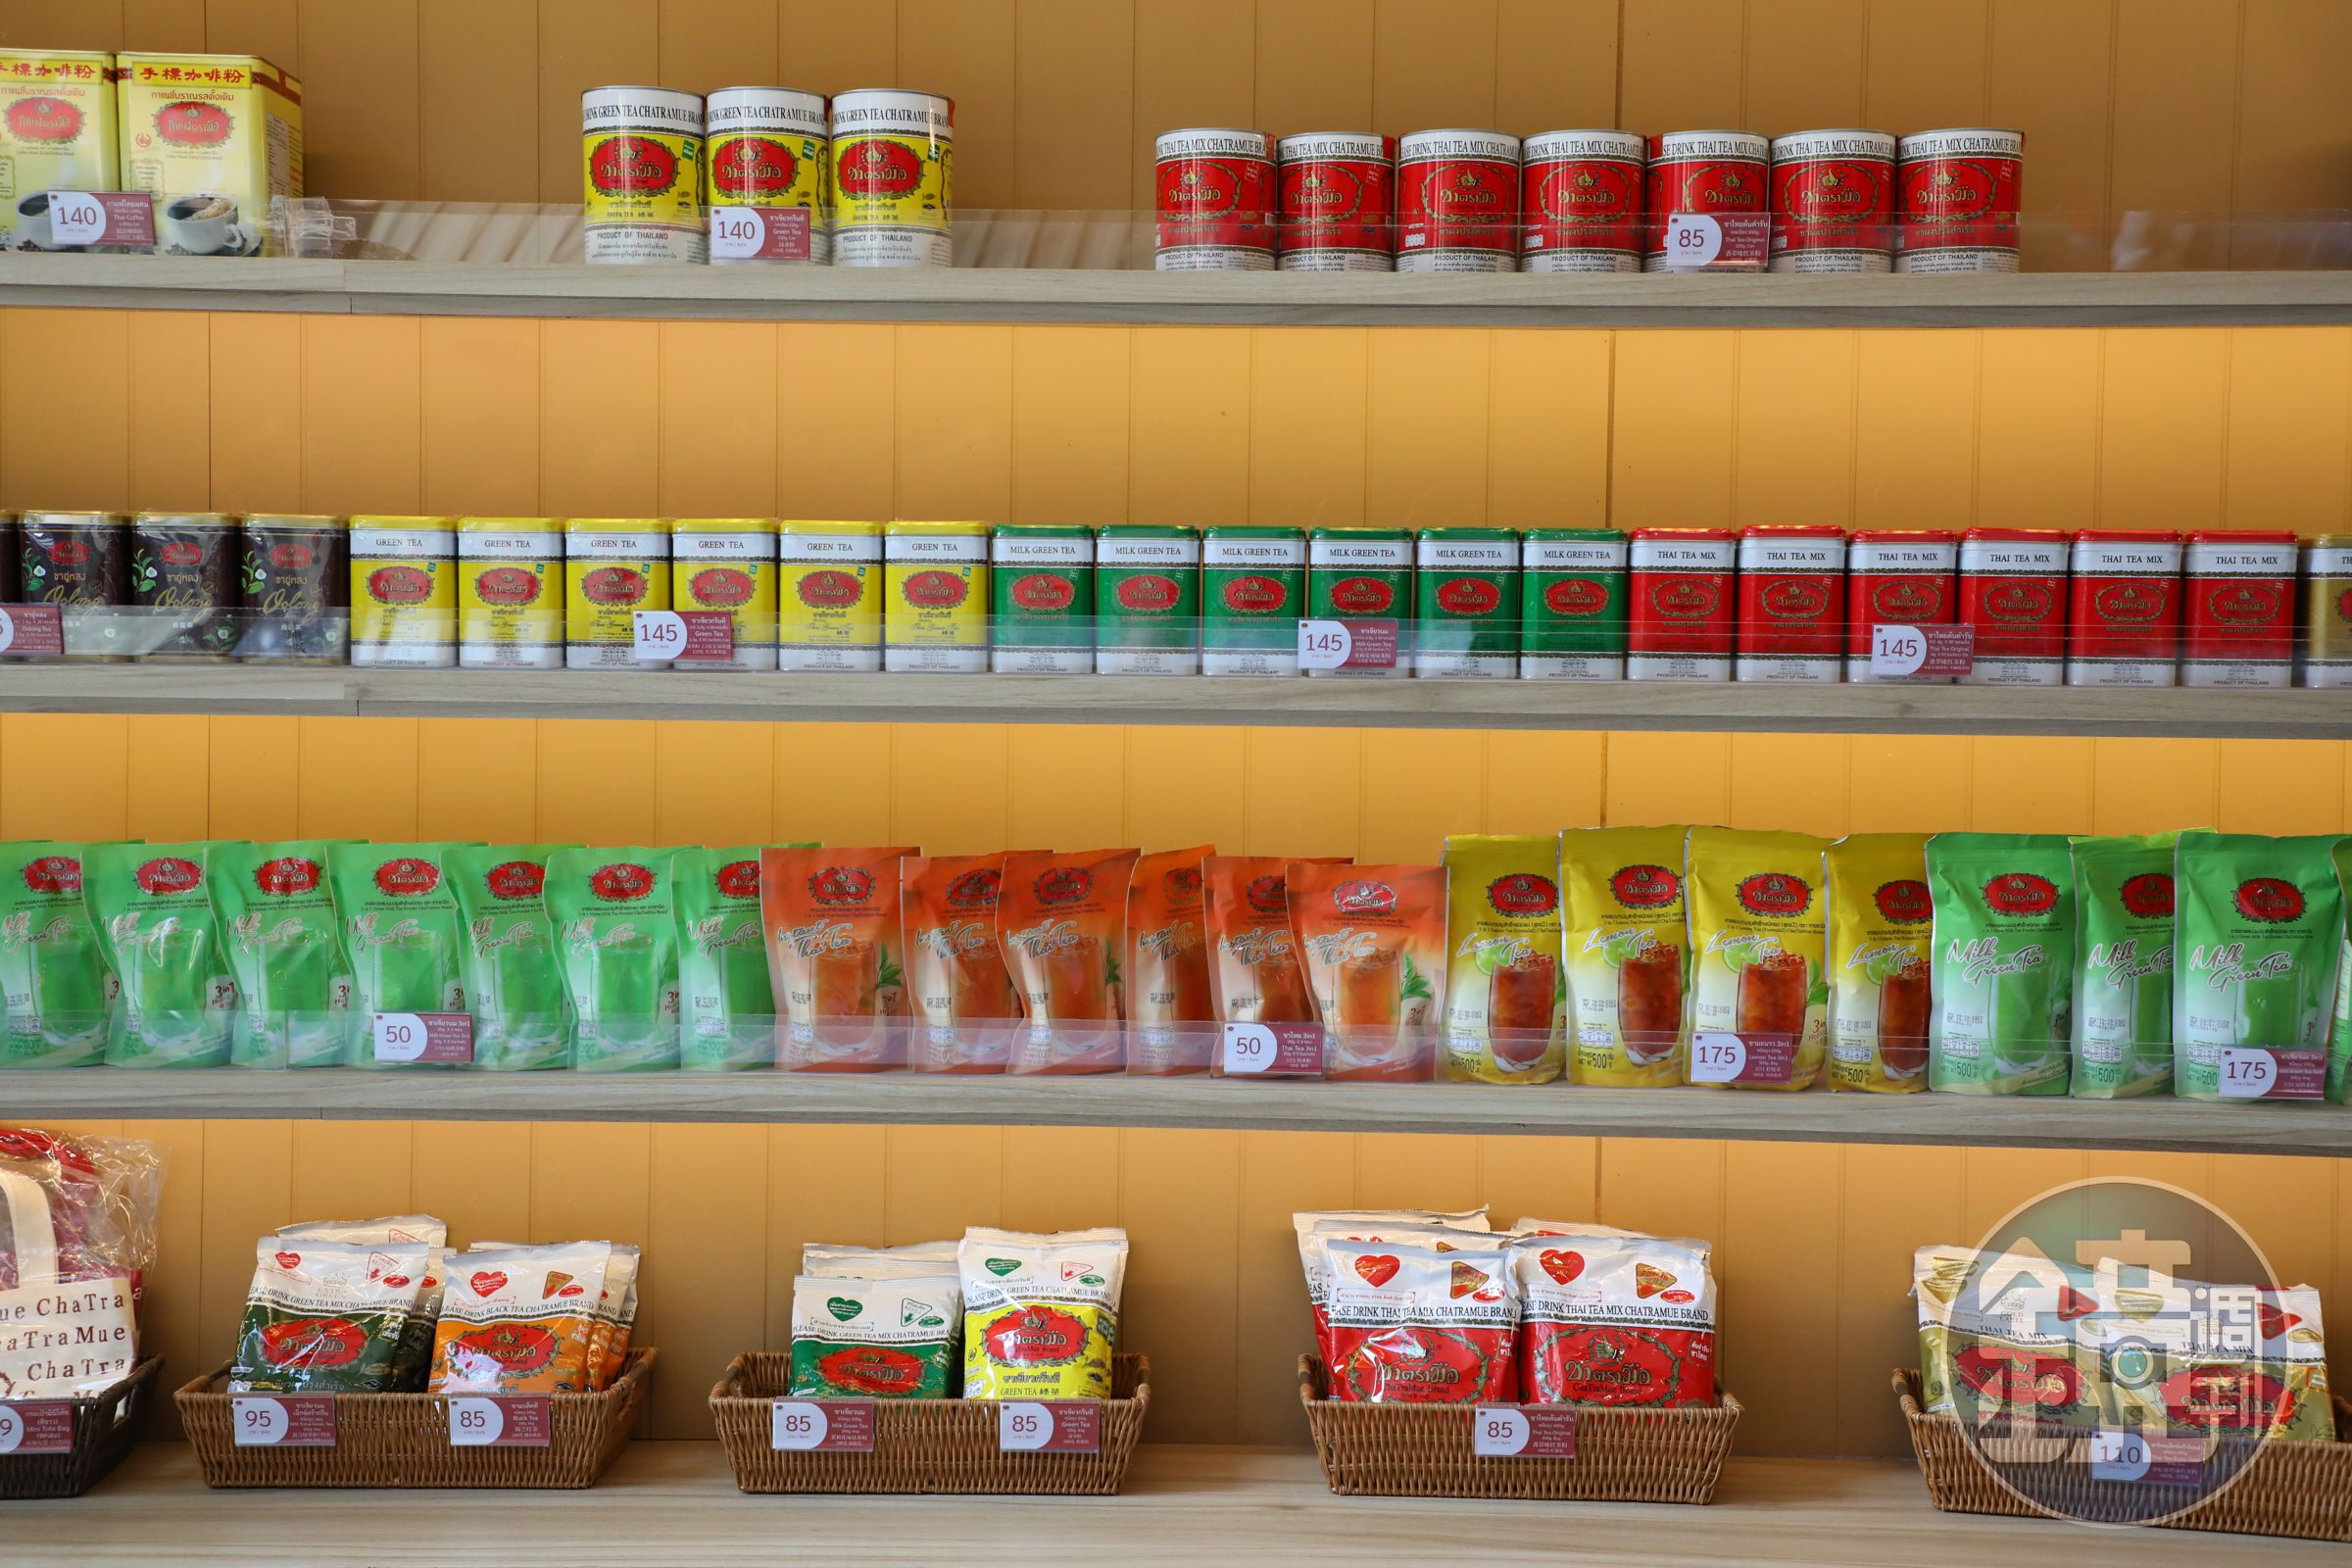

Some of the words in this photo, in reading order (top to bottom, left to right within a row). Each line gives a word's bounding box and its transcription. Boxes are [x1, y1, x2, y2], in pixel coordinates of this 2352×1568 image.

[140, 67, 245, 84] 手標咖啡粉
[599, 106, 620, 118] GREEN
[622, 105, 637, 118] TEA
[639, 106, 687, 122] CHATRAMUE
[719, 106, 742, 119] GREEN
[743, 106, 758, 119] TEA
[759, 106, 807, 121] CHATRAMUE
[847, 109, 868, 122] GREEN
[870, 109, 884, 121] TEA
[1164, 139, 1176, 154] THAI
[1177, 138, 1191, 153] TEA
[1192, 138, 1205, 152] MIX
[1207, 137, 1253, 153] CHATRAMUE
[1434, 140, 1451, 153] THAI
[1453, 140, 1468, 152] TEA
[1470, 140, 1485, 153] MIX
[1912, 141, 1928, 154] THAI
[1929, 139, 1944, 152] TEA
[1945, 139, 1961, 152] MIX
[1963, 138, 2009, 153] CHATRAMUE
[58, 207, 97, 225] 140
[637, 232, 668, 241] THAILAND
[718, 220, 756, 239] 140
[1679, 228, 1704, 248] 85
[640, 624, 677, 642] 145
[1305, 634, 1343, 651] 145
[1880, 639, 1918, 657] 145
[1456, 932, 1511, 957] Lemon
[1583, 926, 1636, 954] Lemon
[1627, 933, 1658, 959] Tea
[1704, 930, 1760, 955] Lemon
[1947, 936, 1998, 962] Milk
[1499, 937, 1532, 967] Tea
[1747, 936, 1781, 964] Tea
[2189, 943, 2242, 973] Milk
[1962, 959, 2016, 986] Green
[2013, 944, 2042, 968] Tea
[2208, 964, 2264, 993] Green
[2259, 952, 2291, 979] Tea
[385, 1025, 412, 1044] 50
[1236, 1037, 1261, 1055] 50
[1698, 1046, 1737, 1064] 175
[2227, 1061, 2267, 1080] 175
[268, 1289, 289, 1302] DRINK
[291, 1296, 316, 1306] GREEN
[316, 1298, 329, 1307] TEA
[331, 1299, 344, 1308] MIX
[464, 1307, 485, 1317] DRINK
[485, 1304, 509, 1314] BLACK
[511, 1304, 524, 1313] TEA
[525, 1299, 568, 1313] CHATRAMUE
[569, 1299, 594, 1310] BRAND
[1352, 1306, 1379, 1317] DRINK
[1381, 1307, 1401, 1318] THAI
[1402, 1306, 1416, 1317] TEA
[1418, 1306, 1435, 1317] MIX
[1436, 1306, 1490, 1318] CHATRAMUE
[1539, 1300, 1564, 1313] DRINK
[1566, 1303, 1587, 1314] THAI
[1589, 1304, 1604, 1315] TEA
[1606, 1305, 1623, 1316] MIX
[1625, 1305, 1679, 1318] CHATRAMUE
[1681, 1308, 1708, 1320] BRAND
[2, 1326, 125, 1350] aTraMue
[816, 1328, 838, 1338] DRINK
[863, 1331, 877, 1340] TEA
[892, 1329, 936, 1339] CHATRAMUE
[1001, 1388, 1022, 1396] GREEN
[1024, 1388, 1037, 1396] TEA
[245, 1410, 271, 1427] 95
[460, 1411, 485, 1428] 85
[786, 1415, 810, 1432] 85
[1011, 1415, 1037, 1432] 85
[1488, 1421, 1513, 1438] 85
[2100, 1446, 2141, 1465] 110
